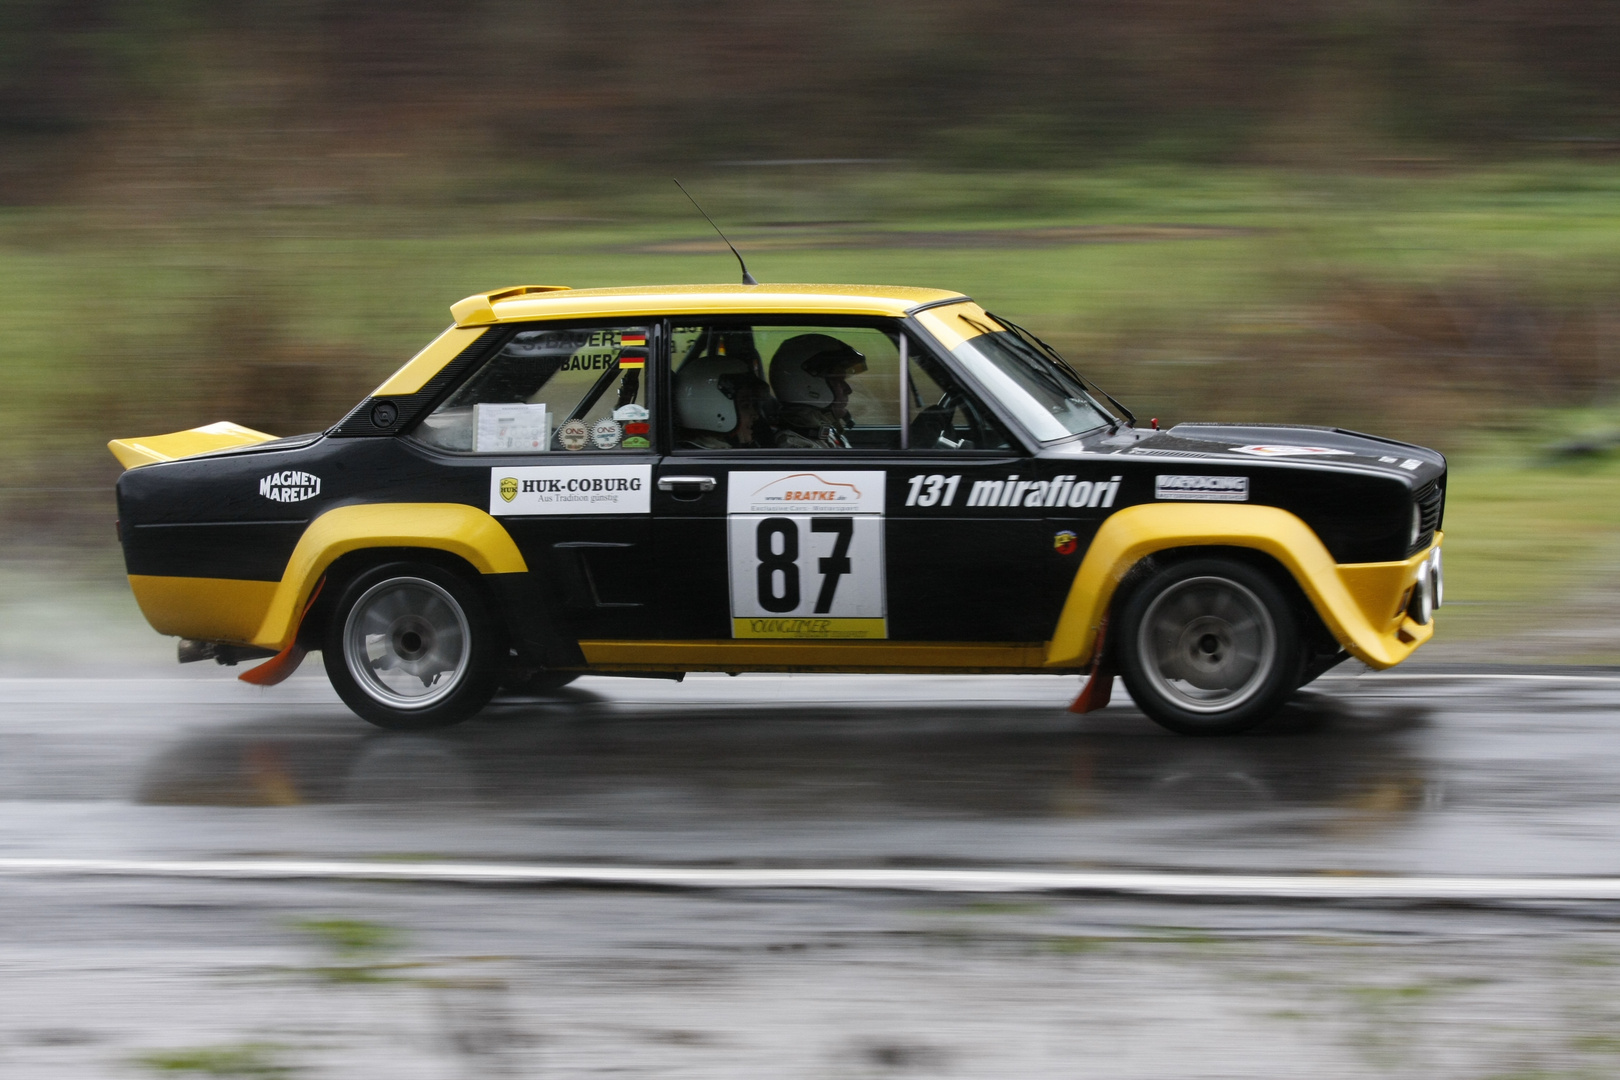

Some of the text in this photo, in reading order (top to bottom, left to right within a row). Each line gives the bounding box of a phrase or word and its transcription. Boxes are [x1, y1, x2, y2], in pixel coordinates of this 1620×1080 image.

[546, 332, 615, 347] BAUER
[561, 354, 612, 371] BAUER
[565, 427, 584, 435] ONS
[597, 426, 616, 434] ONS
[259, 471, 321, 491] MAGNETI
[522, 478, 642, 493] HUK-COBURG
[500, 486, 519, 494] HUK
[904, 474, 1123, 508] 131 mirafiori
[538, 493, 619, 503] Aus Tradition günstig
[756, 516, 855, 614] 87
